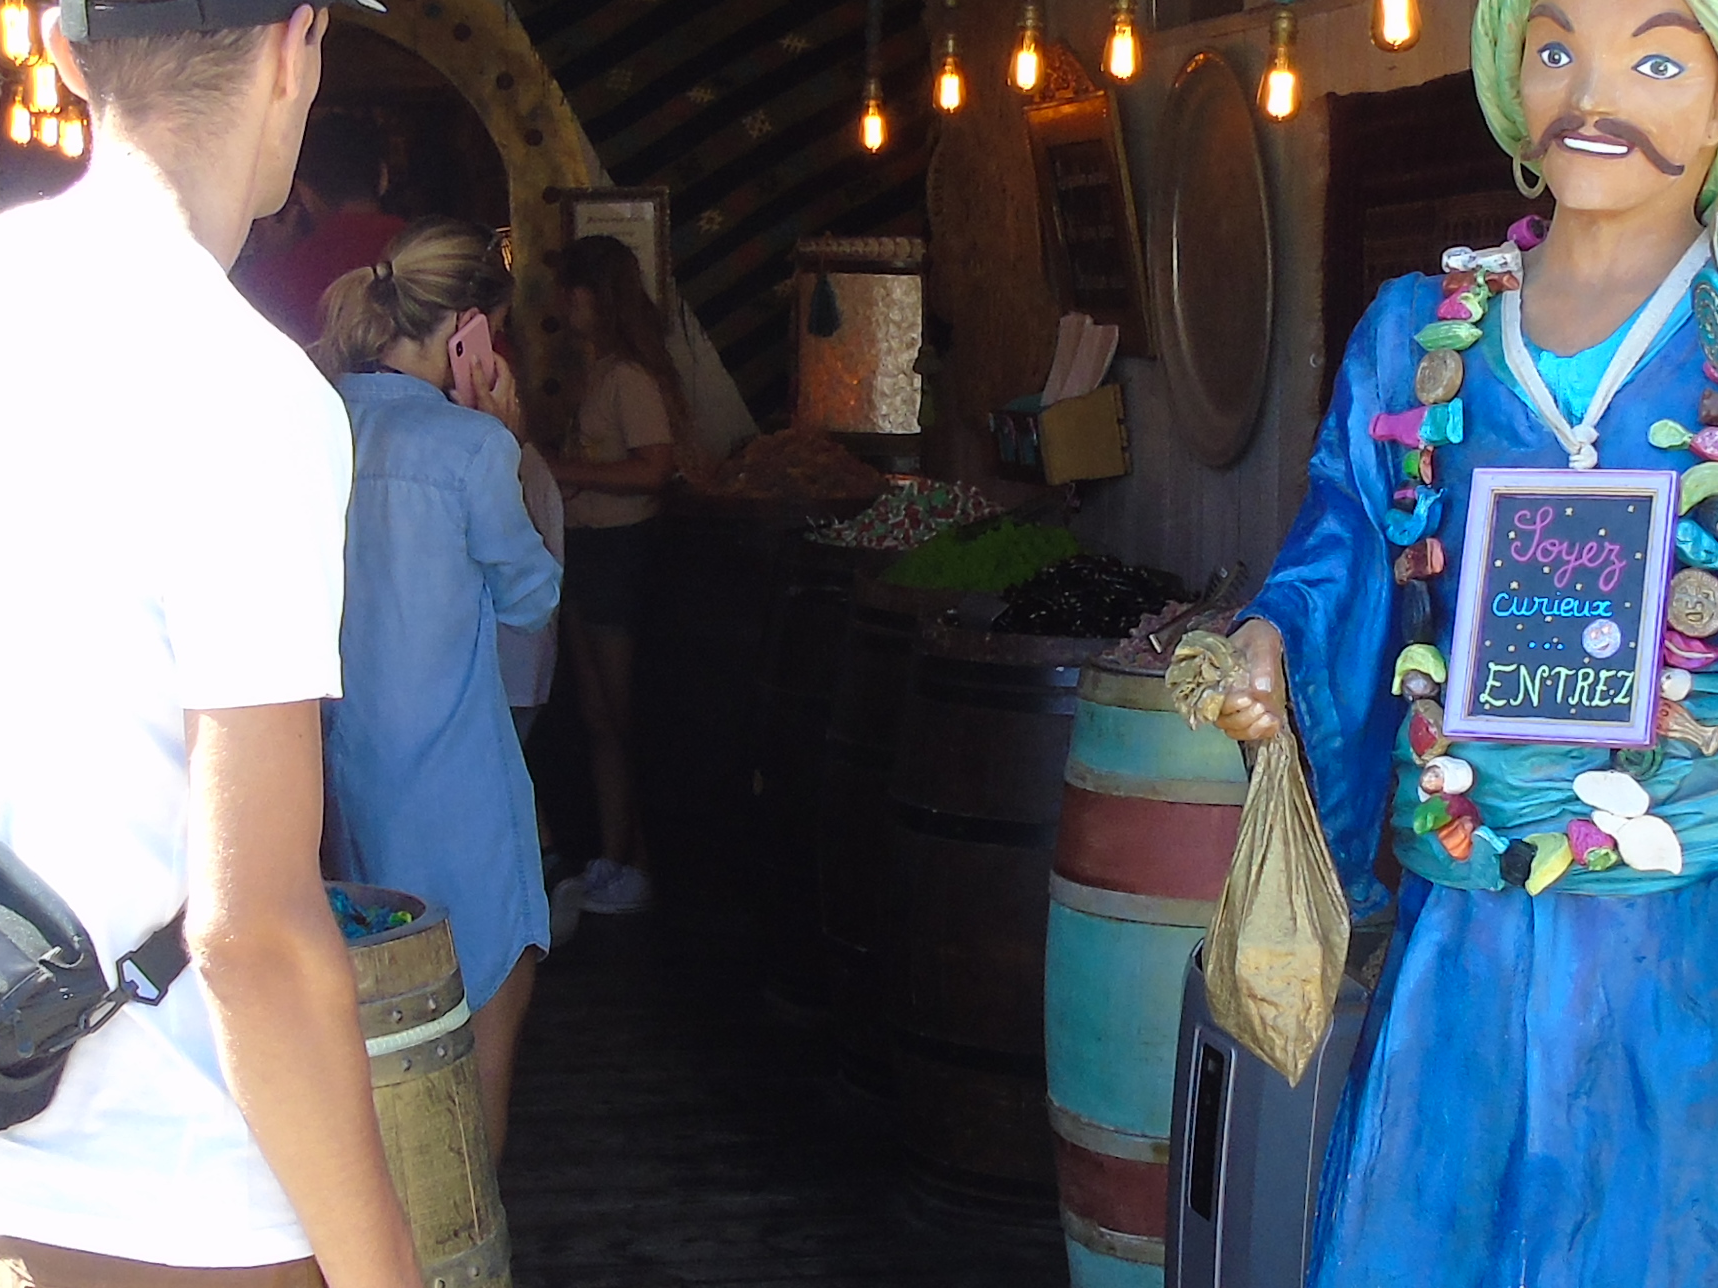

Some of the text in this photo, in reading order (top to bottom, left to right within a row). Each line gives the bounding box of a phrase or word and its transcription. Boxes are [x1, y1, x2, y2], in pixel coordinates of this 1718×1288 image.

[1510, 506, 1627, 592] Soyez
[1491, 591, 1614, 618] curieux
[1478, 661, 1636, 708] ENTREZ
